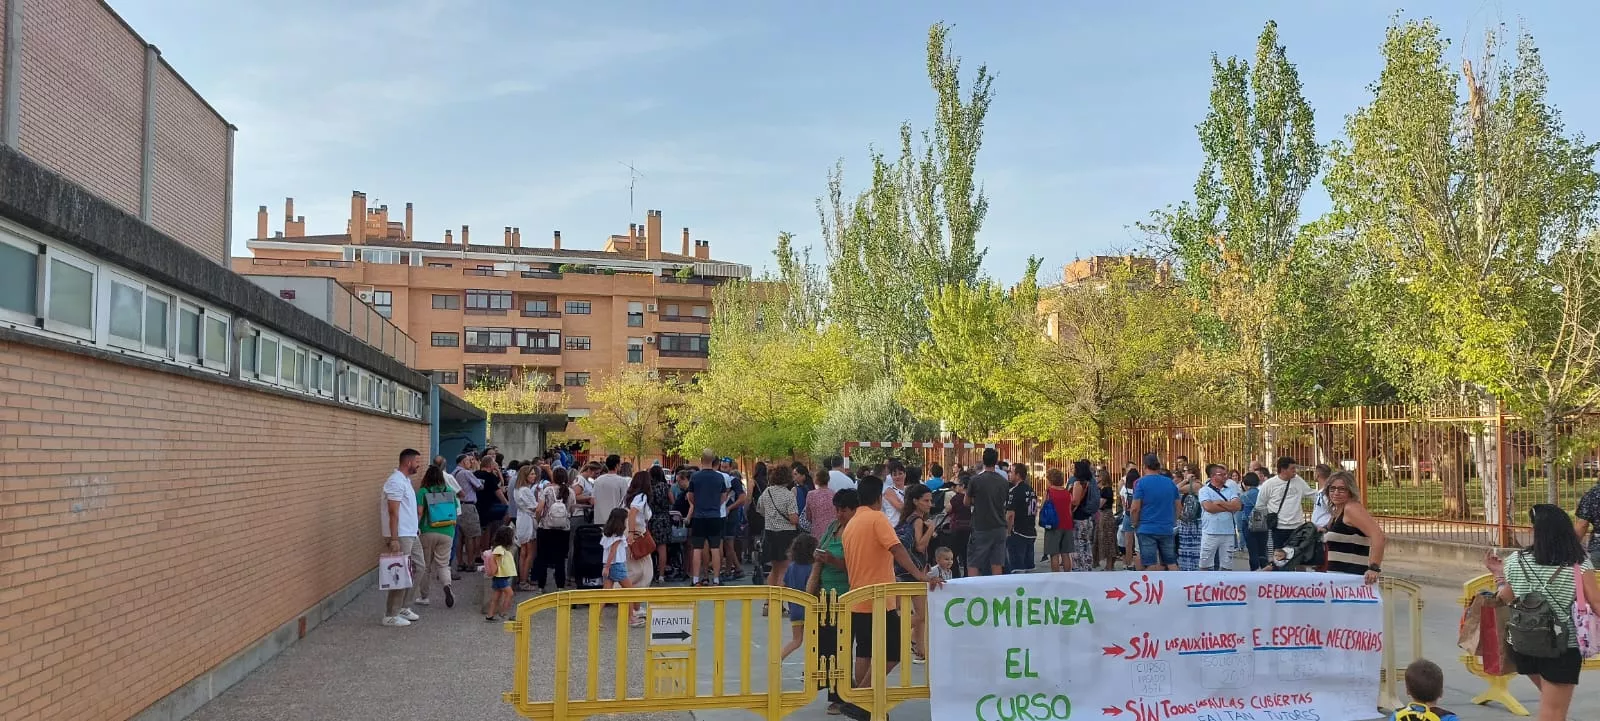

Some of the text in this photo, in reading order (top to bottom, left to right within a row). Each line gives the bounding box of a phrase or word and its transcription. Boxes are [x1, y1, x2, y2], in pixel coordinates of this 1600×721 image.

[1128, 574, 1164, 605] SIN
[1329, 580, 1378, 600] INFANTIL
[652, 617, 692, 626] INFANTIL
[944, 587, 1095, 627] COMIENZA
[1124, 632, 1160, 660] SIN
[1272, 623, 1324, 646] ESPECIAL
[1326, 628, 1383, 652] NECESARIAS
[1006, 648, 1039, 679] EL
[975, 693, 1072, 721] CURSO
[1125, 697, 1160, 721] SIN
[1250, 692, 1313, 709] CUBIERTAS
